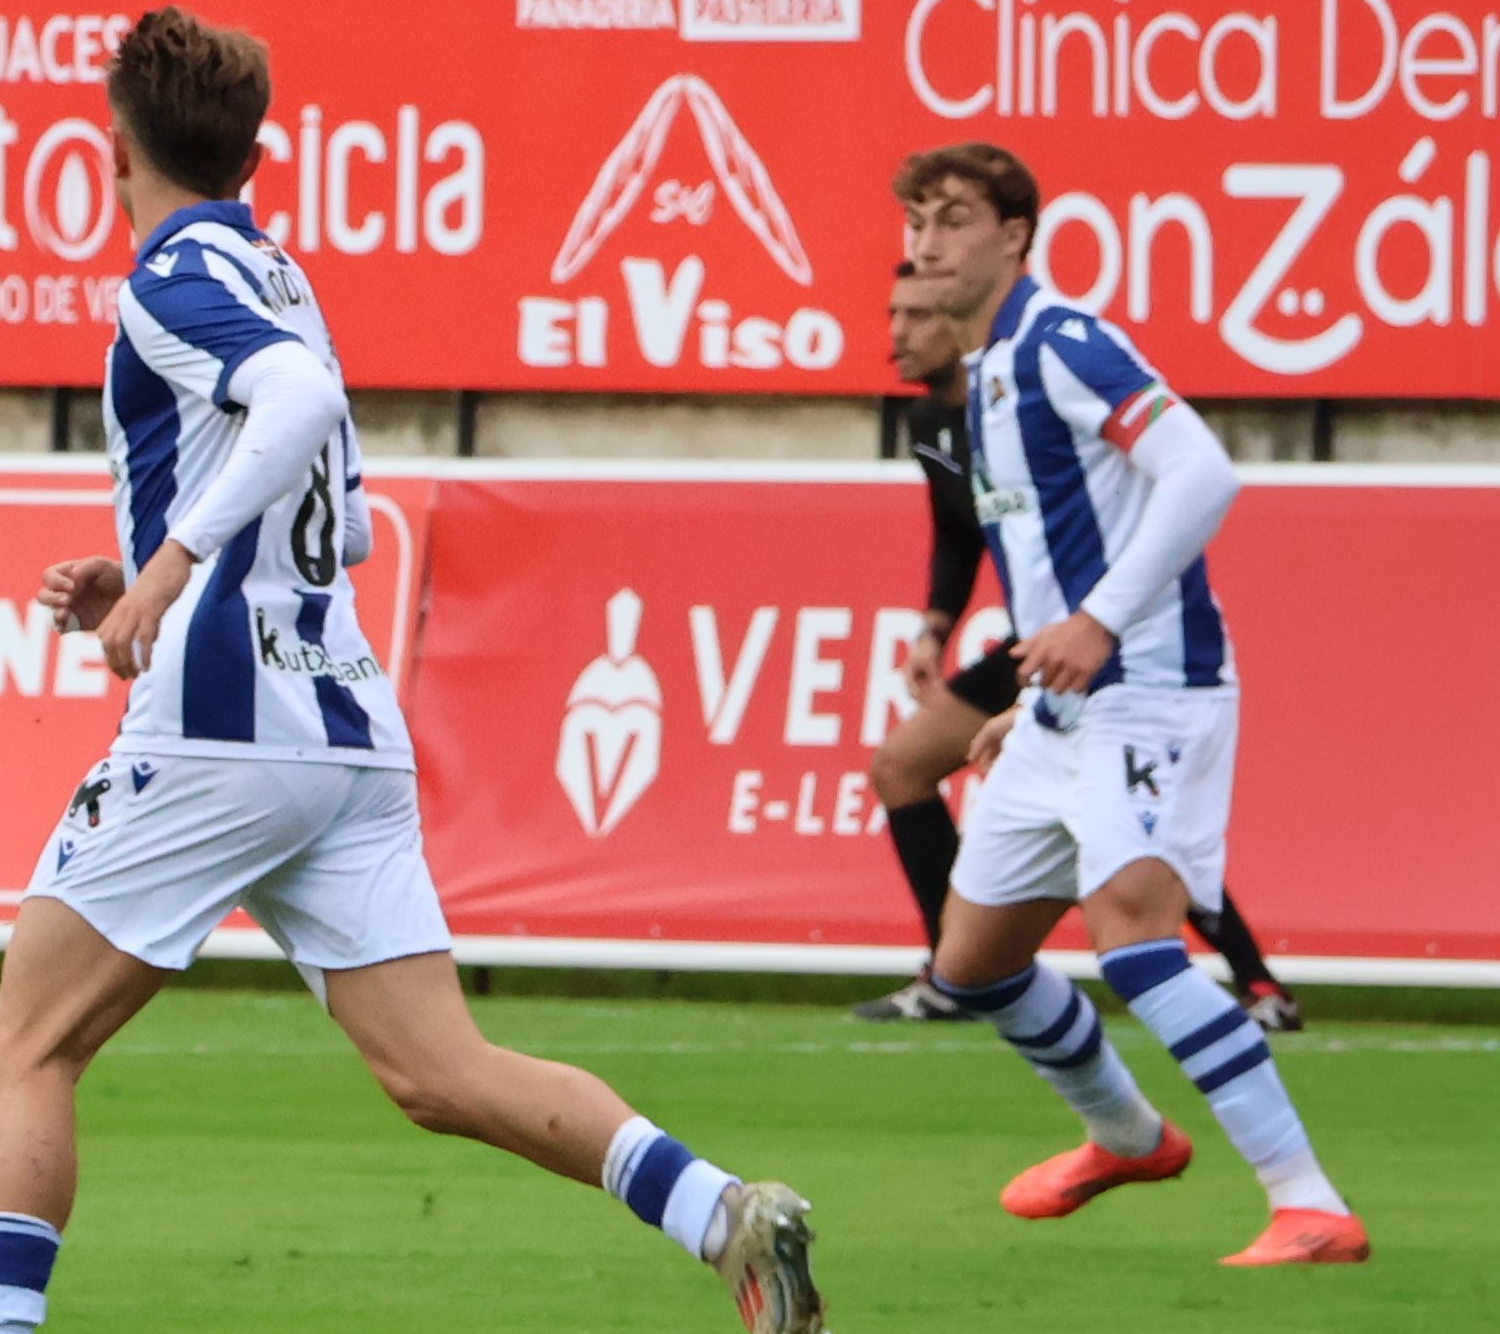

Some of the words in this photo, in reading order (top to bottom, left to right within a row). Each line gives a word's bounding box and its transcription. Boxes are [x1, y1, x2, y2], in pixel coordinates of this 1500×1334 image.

[34, 274, 79, 324] DE
[517, 295, 608, 367] El
[621, 254, 844, 370] Viso
